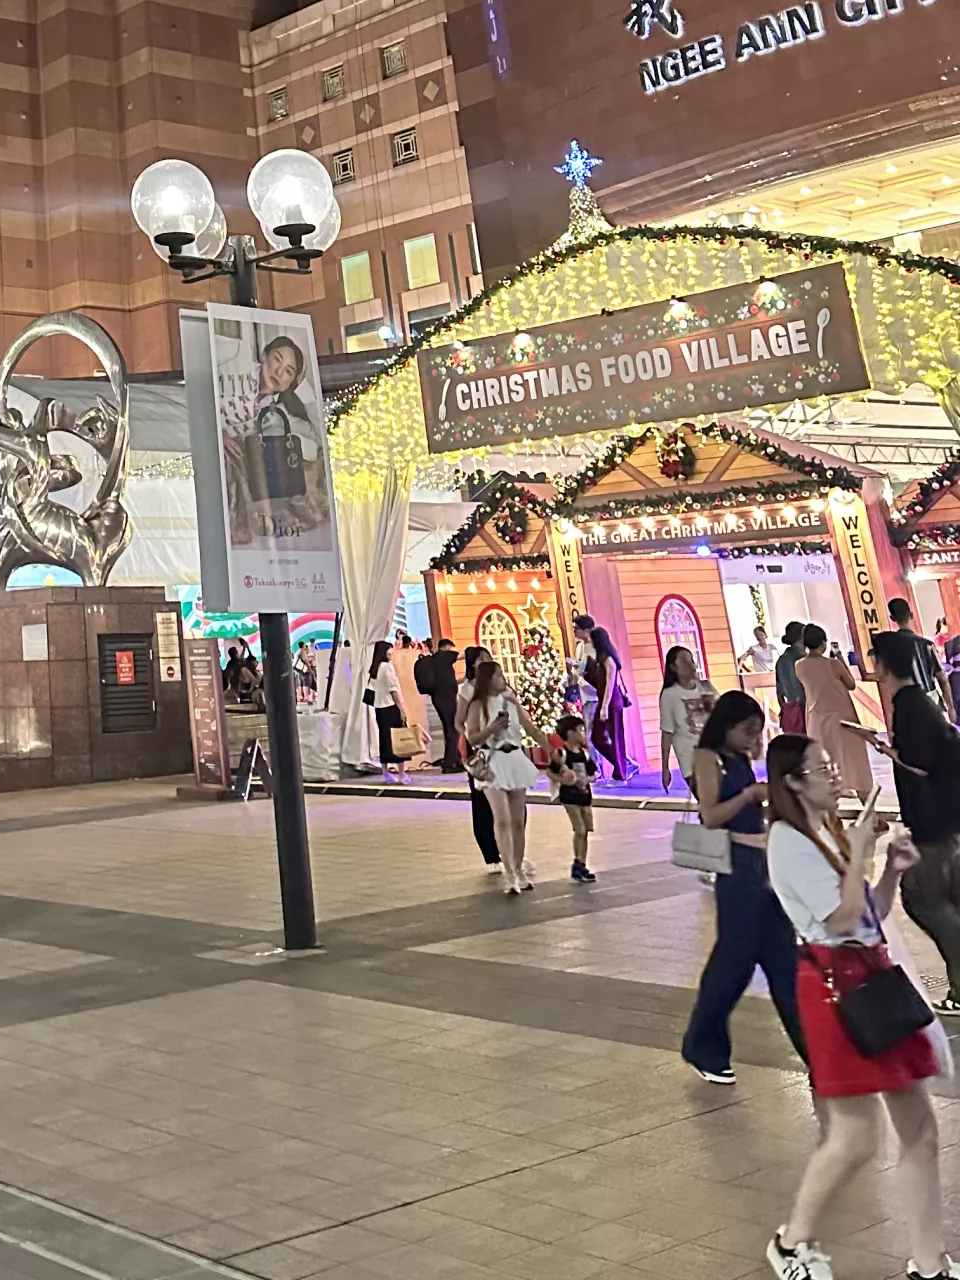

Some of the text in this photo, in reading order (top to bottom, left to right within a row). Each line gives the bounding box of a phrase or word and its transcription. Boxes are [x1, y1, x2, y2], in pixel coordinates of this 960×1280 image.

[638, 33, 727, 95] NGEE
[734, 0, 826, 63] ANN
[455, 320, 812, 411] CHRISTMAS FOOD VILLAGE
[260, 515, 302, 538] Dior
[581, 512, 822, 546] THE GREAT CHRISTMAS VILLAGE
